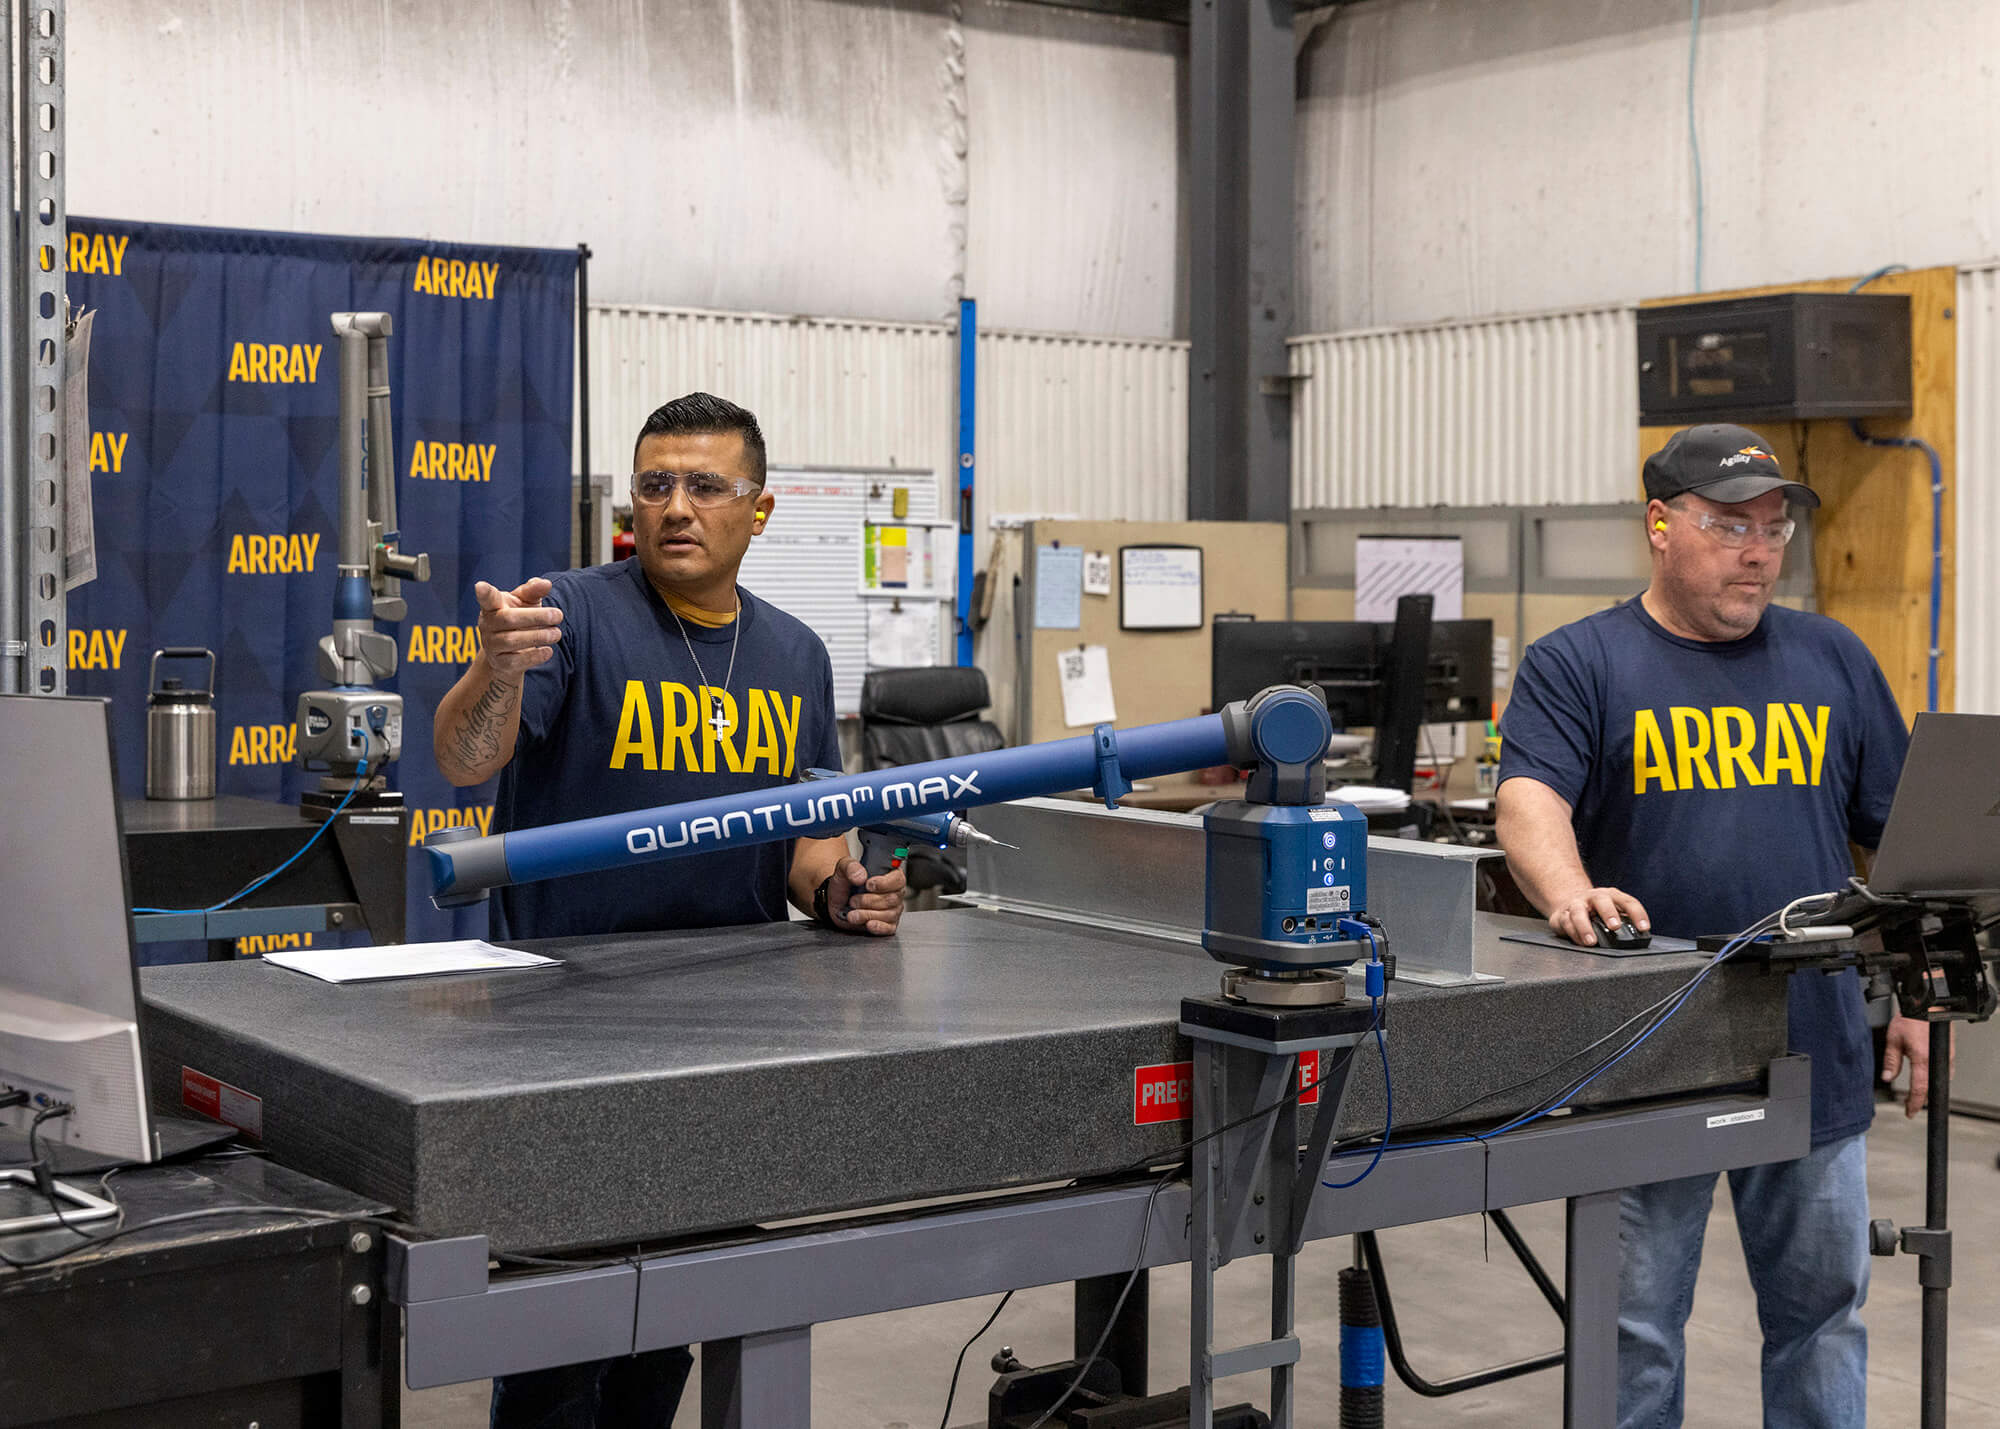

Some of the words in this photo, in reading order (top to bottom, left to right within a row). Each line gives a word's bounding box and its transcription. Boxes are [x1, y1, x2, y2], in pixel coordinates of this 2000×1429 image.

[64, 231, 129, 276] RAY
[413, 255, 500, 300] ARRAY
[228, 342, 323, 384] ARRAY
[409, 440, 497, 482] ARRAY
[1719, 453, 1751, 467] Agility
[227, 533, 321, 574] ARRAY
[66, 629, 128, 671] RAY
[229, 723, 297, 766] ARRA
[609, 679, 802, 778] ARRAY
[1633, 702, 1831, 795] ARRAY
[881, 769, 982, 811] MAX
[1142, 1078, 1189, 1107] PREC
